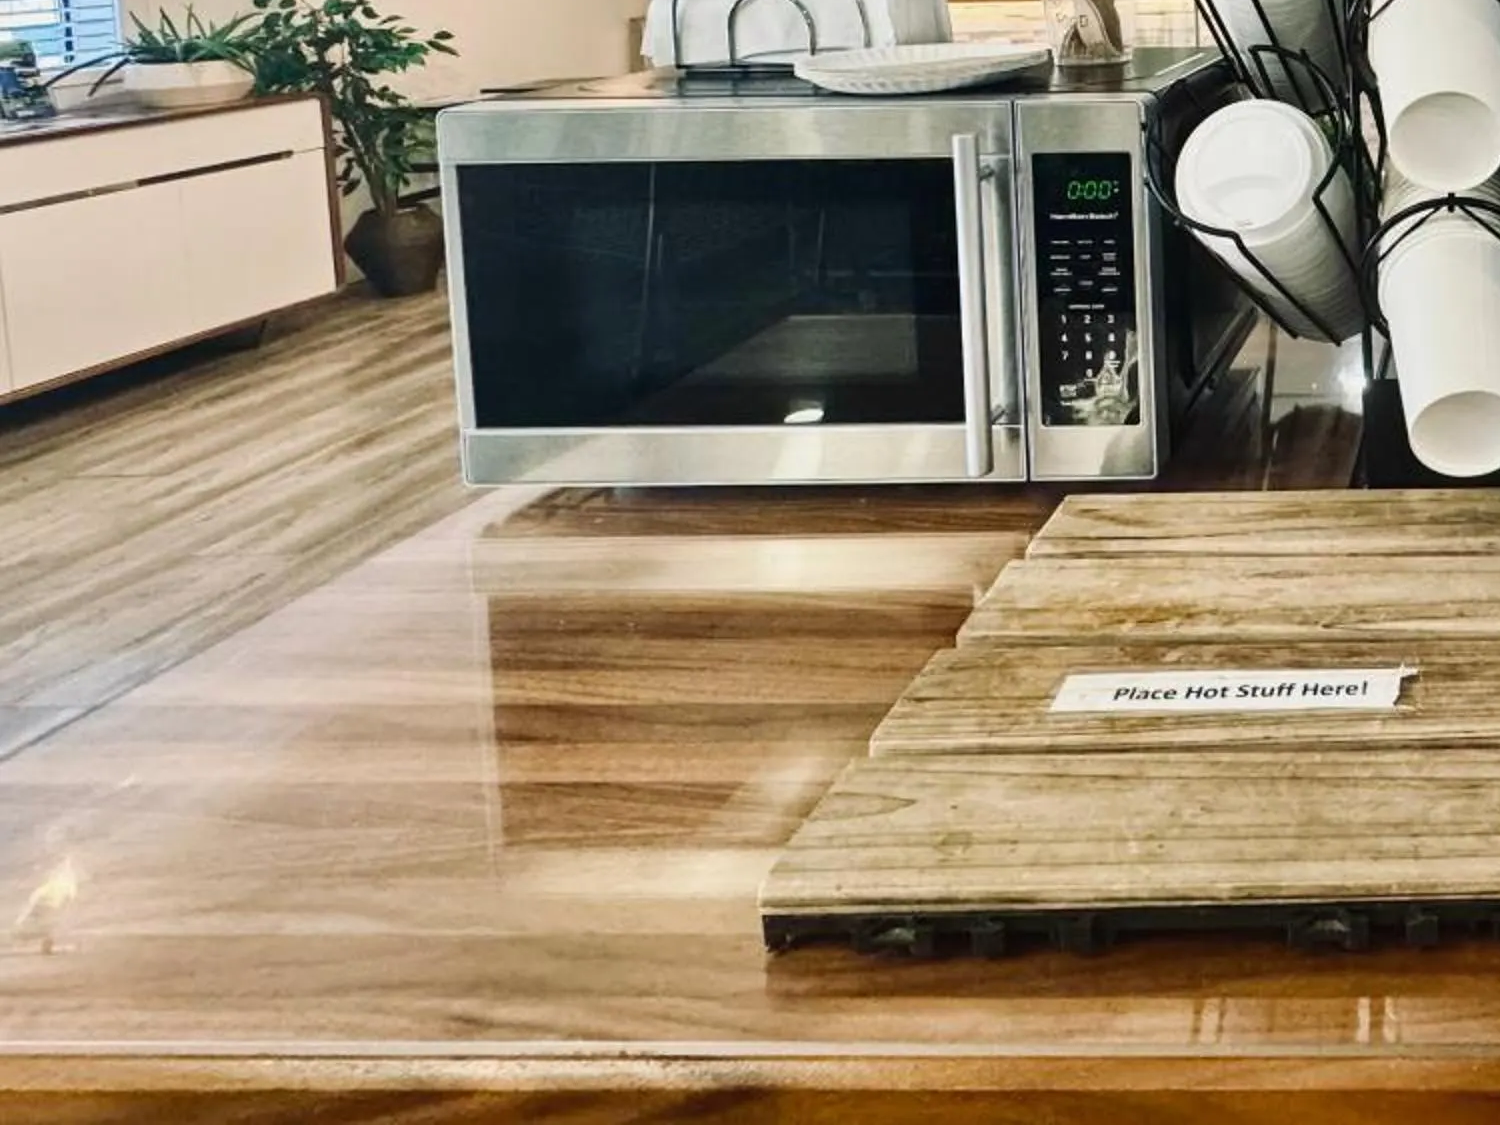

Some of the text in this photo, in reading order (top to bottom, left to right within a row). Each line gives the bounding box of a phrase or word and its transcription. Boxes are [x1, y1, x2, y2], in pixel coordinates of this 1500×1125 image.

[1113, 680, 1368, 701] Place Hot Stuff Here!
